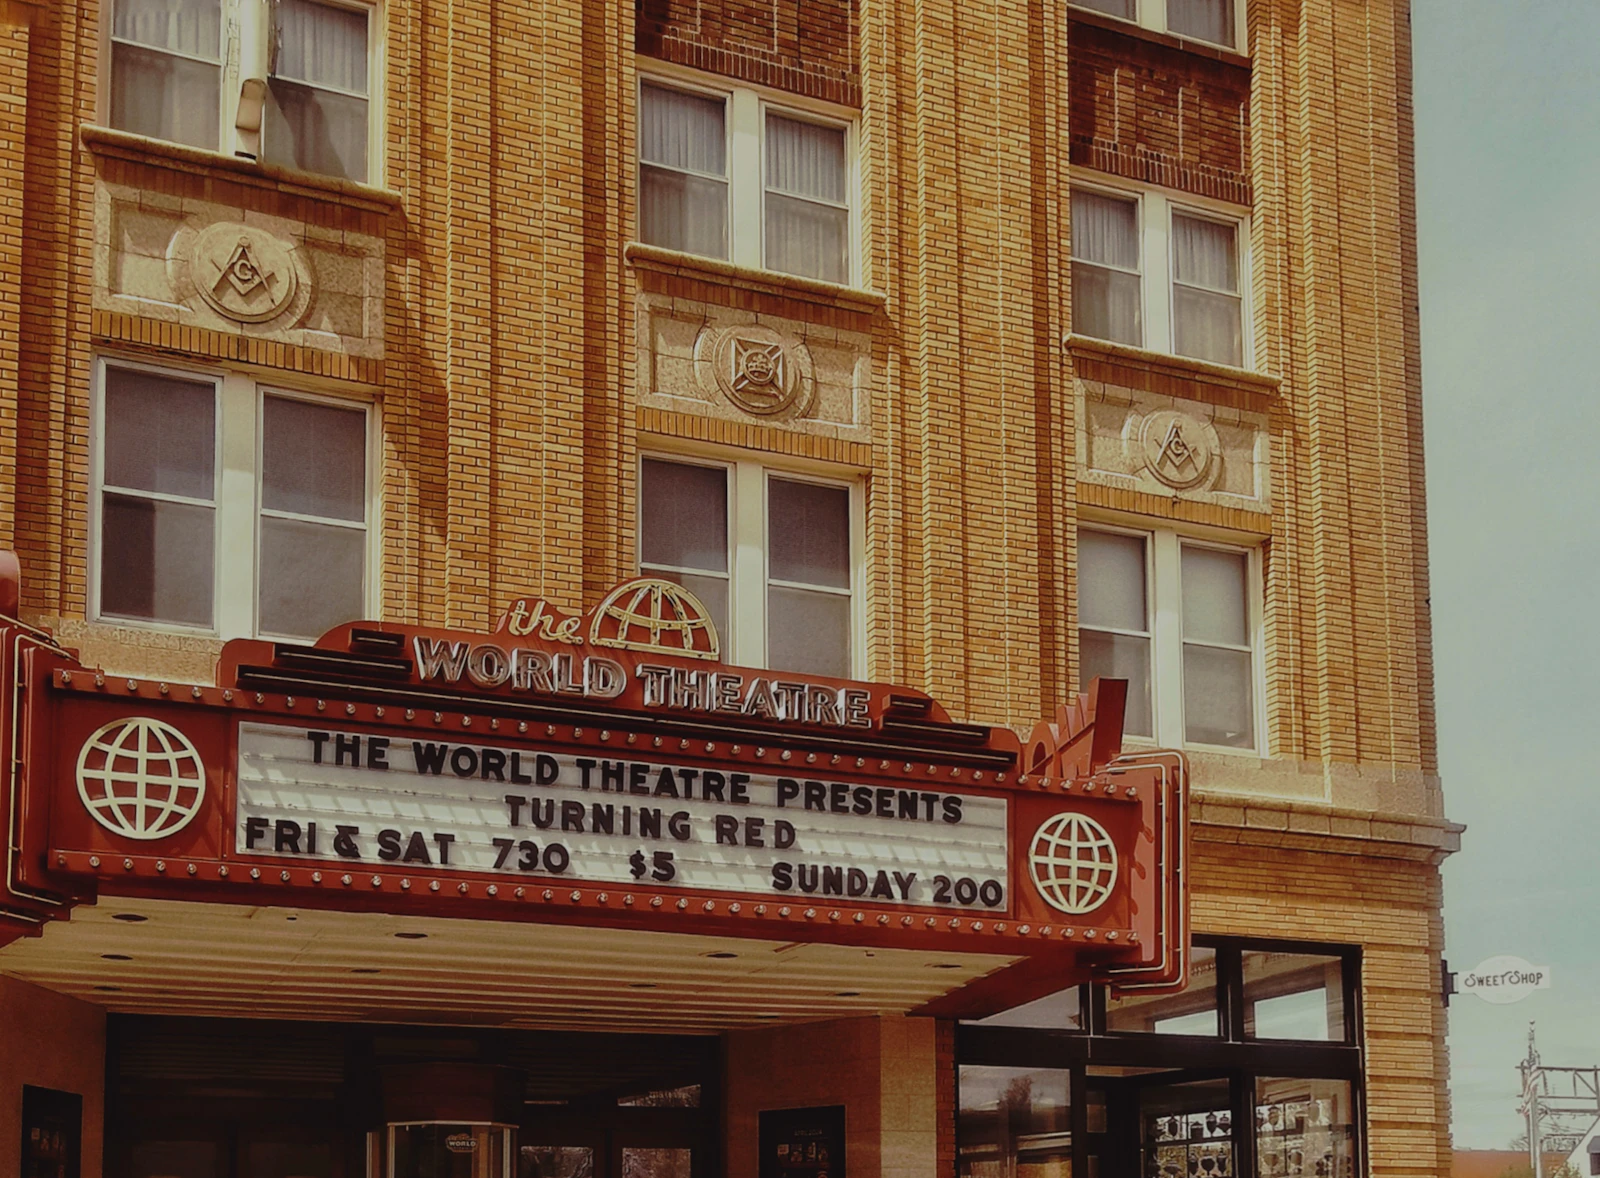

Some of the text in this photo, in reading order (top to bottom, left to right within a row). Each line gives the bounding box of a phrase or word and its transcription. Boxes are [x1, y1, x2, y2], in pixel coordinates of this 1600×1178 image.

[508, 600, 584, 645] the
[413, 635, 872, 728] WORLD THEATRE
[307, 731, 963, 824] THE WORLD THEATRE PRESENTS
[504, 795, 796, 849] TURNING RED
[246, 817, 1002, 907] FRI & SAT 730 $5 SUNDAY 200
[1464, 970, 1544, 987] SWEET SHOP
